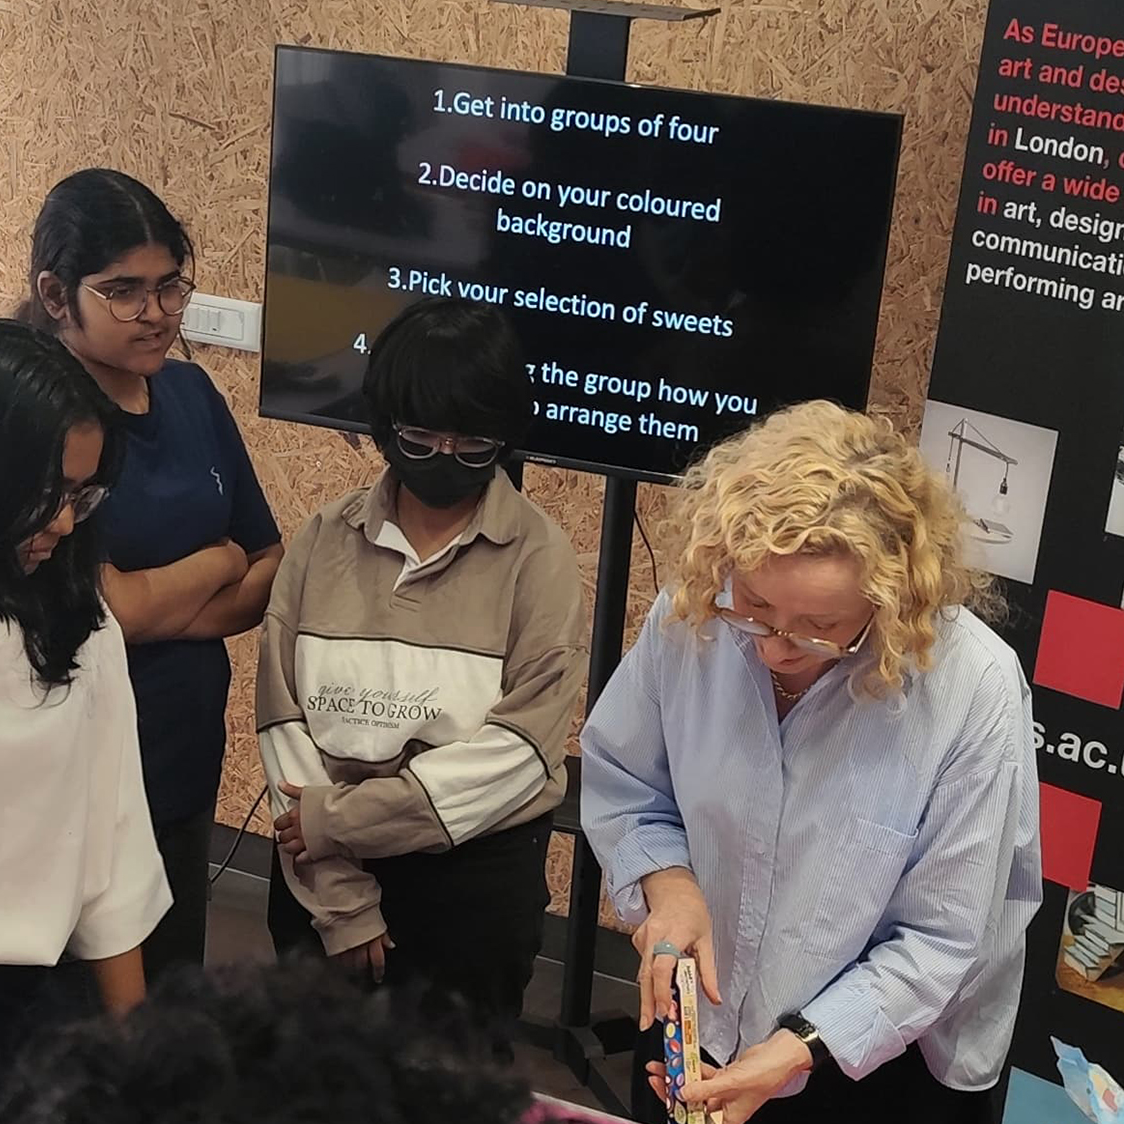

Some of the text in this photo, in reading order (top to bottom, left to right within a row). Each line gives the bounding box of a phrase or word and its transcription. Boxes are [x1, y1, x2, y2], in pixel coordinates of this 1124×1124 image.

[1003, 18, 1035, 43] As
[998, 58, 1033, 79] art
[1039, 65, 1084, 88] and
[433, 89, 720, 144] 1.Get into groups of four
[987, 122, 1008, 147] in
[1015, 127, 1109, 170] London,
[417, 162, 721, 222] 2.Decide on your coloured
[982, 160, 1120, 203] offer a wide
[496, 208, 631, 248] background
[977, 190, 998, 216] in
[1003, 202, 1042, 228] art,
[387, 267, 452, 297] 3.Pick
[514, 288, 615, 320] selection
[622, 302, 649, 324] of
[652, 308, 734, 338] sweets
[965, 262, 1095, 310] performing
[353, 333, 372, 355] 4.
[541, 361, 578, 387] the
[584, 371, 651, 400] group
[658, 378, 709, 406] how
[715, 391, 758, 415] you
[546, 403, 632, 434] arrange
[638, 413, 699, 442] them
[307, 695, 355, 714] SPACE
